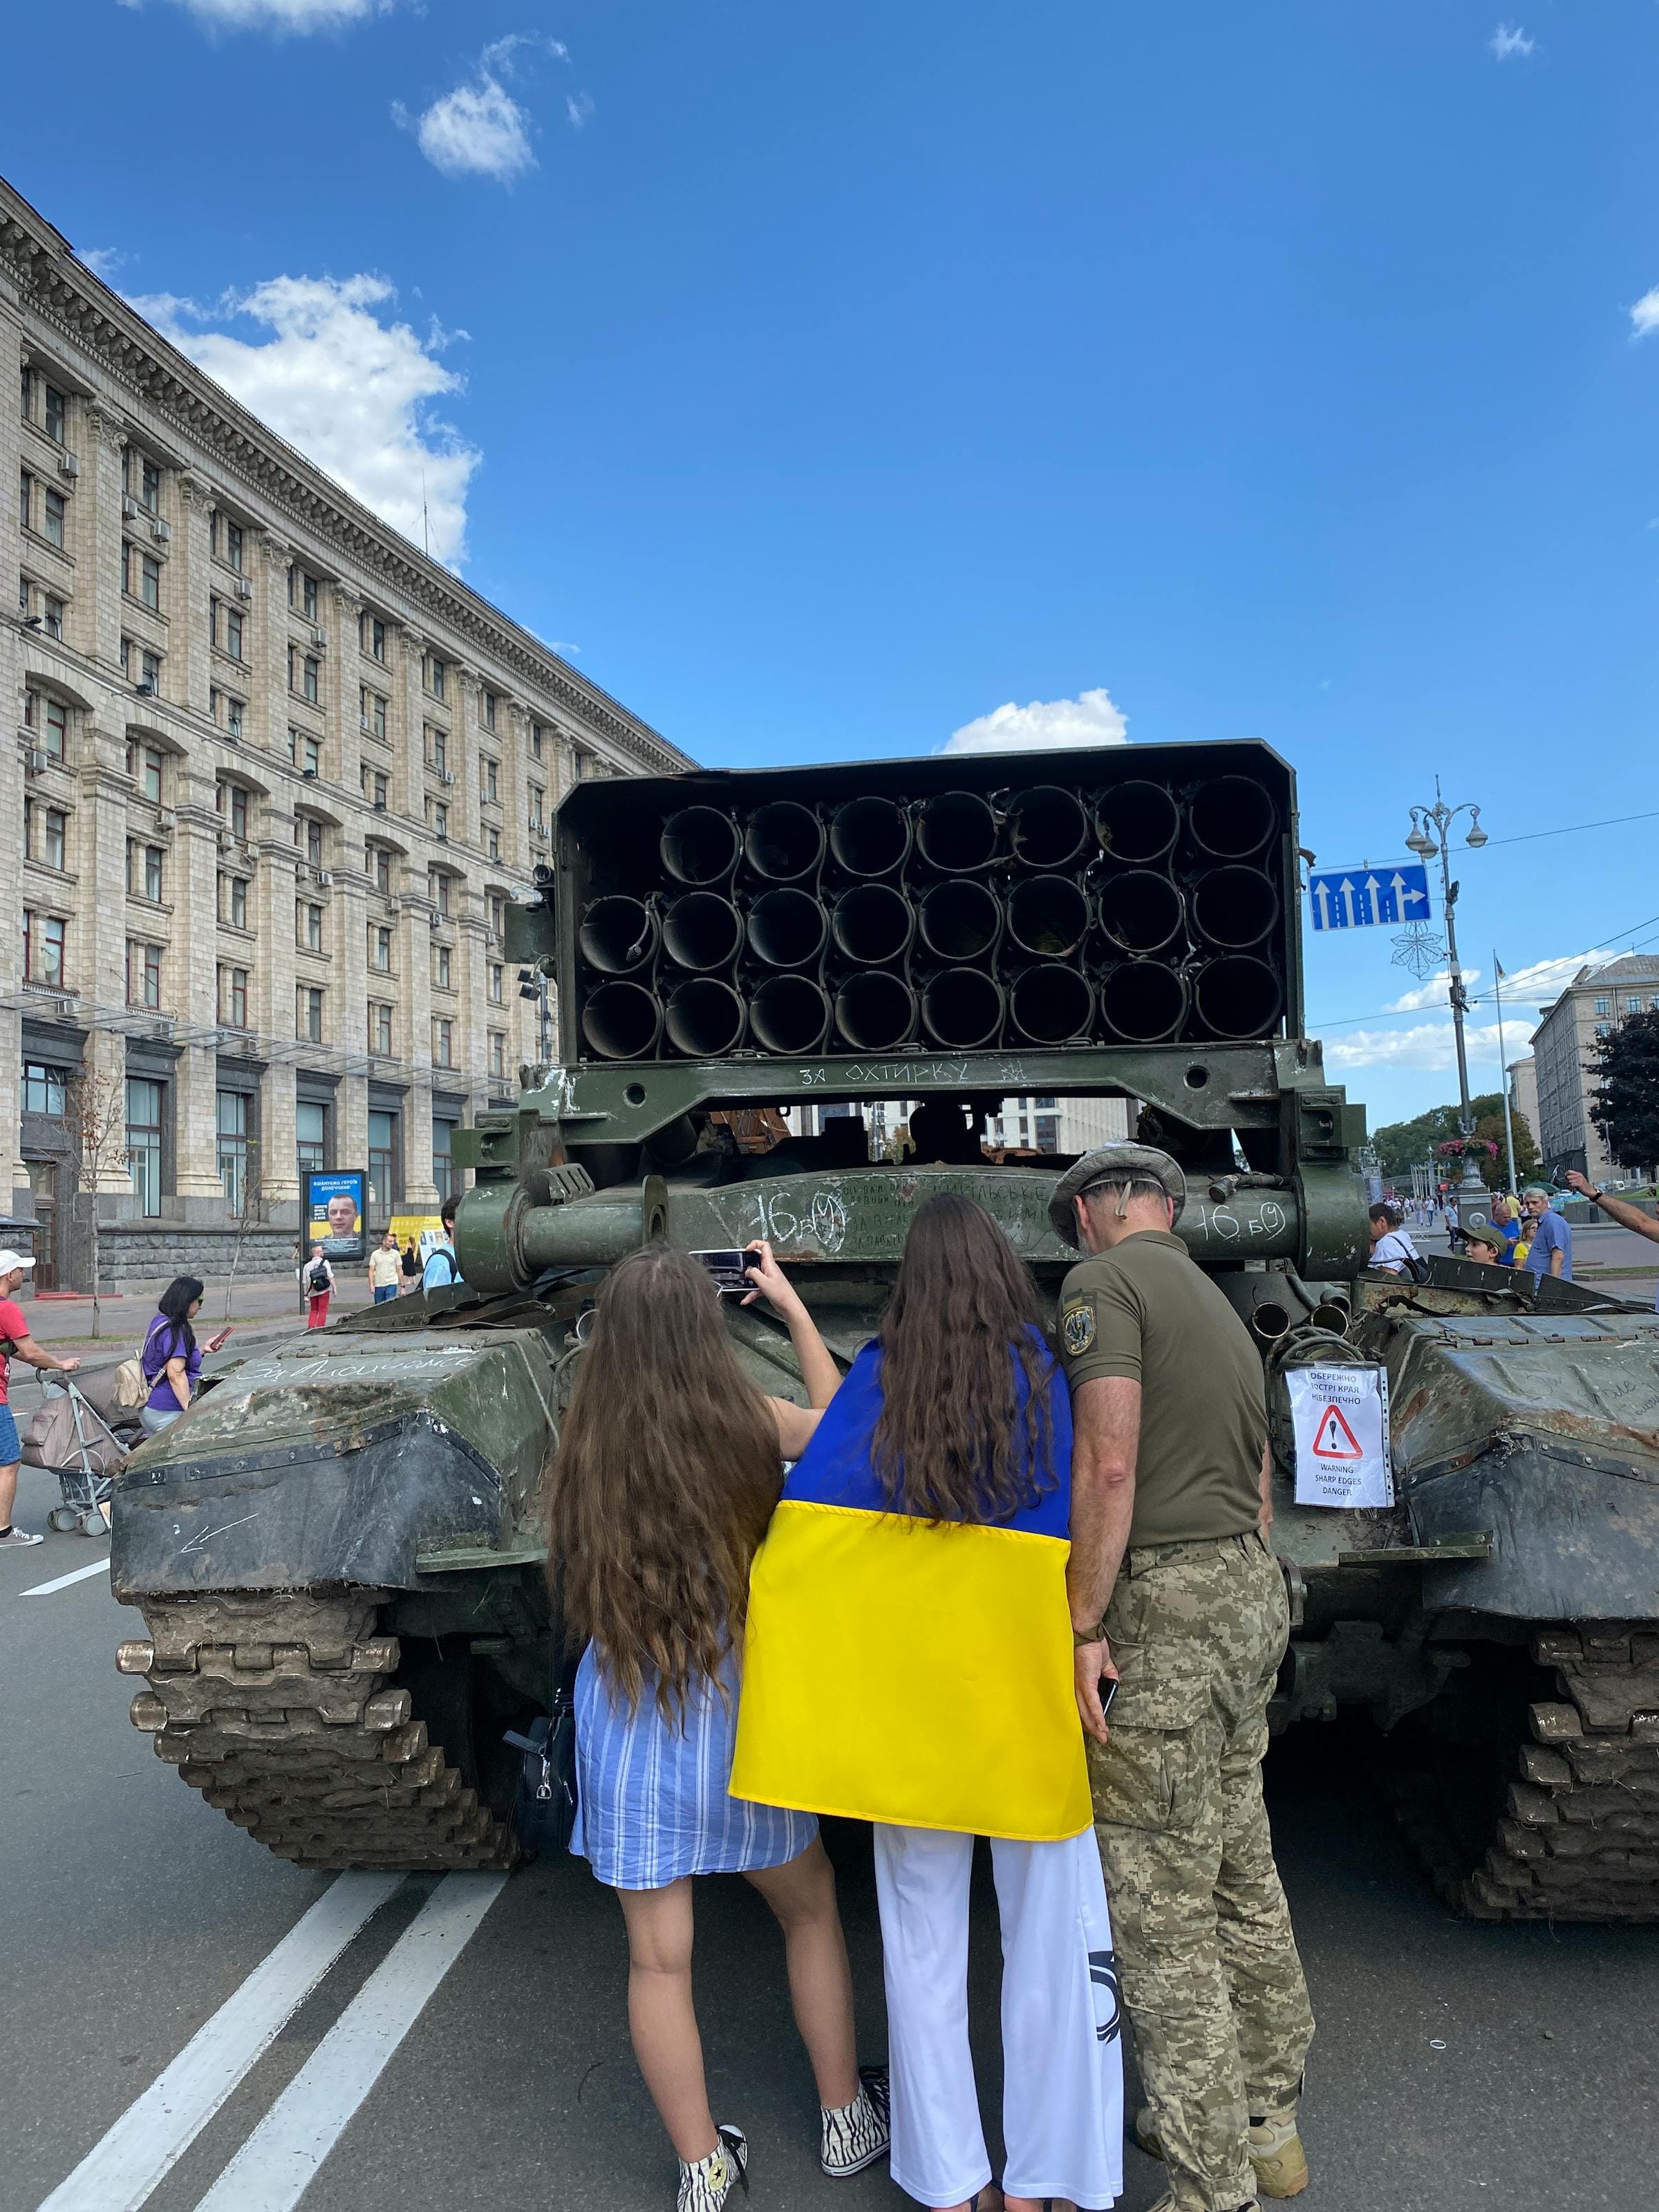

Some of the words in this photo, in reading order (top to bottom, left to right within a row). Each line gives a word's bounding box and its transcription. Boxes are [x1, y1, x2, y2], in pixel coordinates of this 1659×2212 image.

[799, 1068, 825, 1085] ЗА
[845, 1062, 969, 1083] ОХТИРКУ
[1310, 1372, 1356, 1382] ОБЕРЕЖНО
[1311, 1382, 1335, 1391] ГОСТРІ
[1312, 1394, 1361, 1405] НЕБЕЗПЕЧНО
[1320, 1463, 1354, 1474] WARNING
[1315, 1474, 1336, 1483] SHARP
[1338, 1477, 1362, 1485] EDGES
[1322, 1487, 1352, 1496] DANGER
